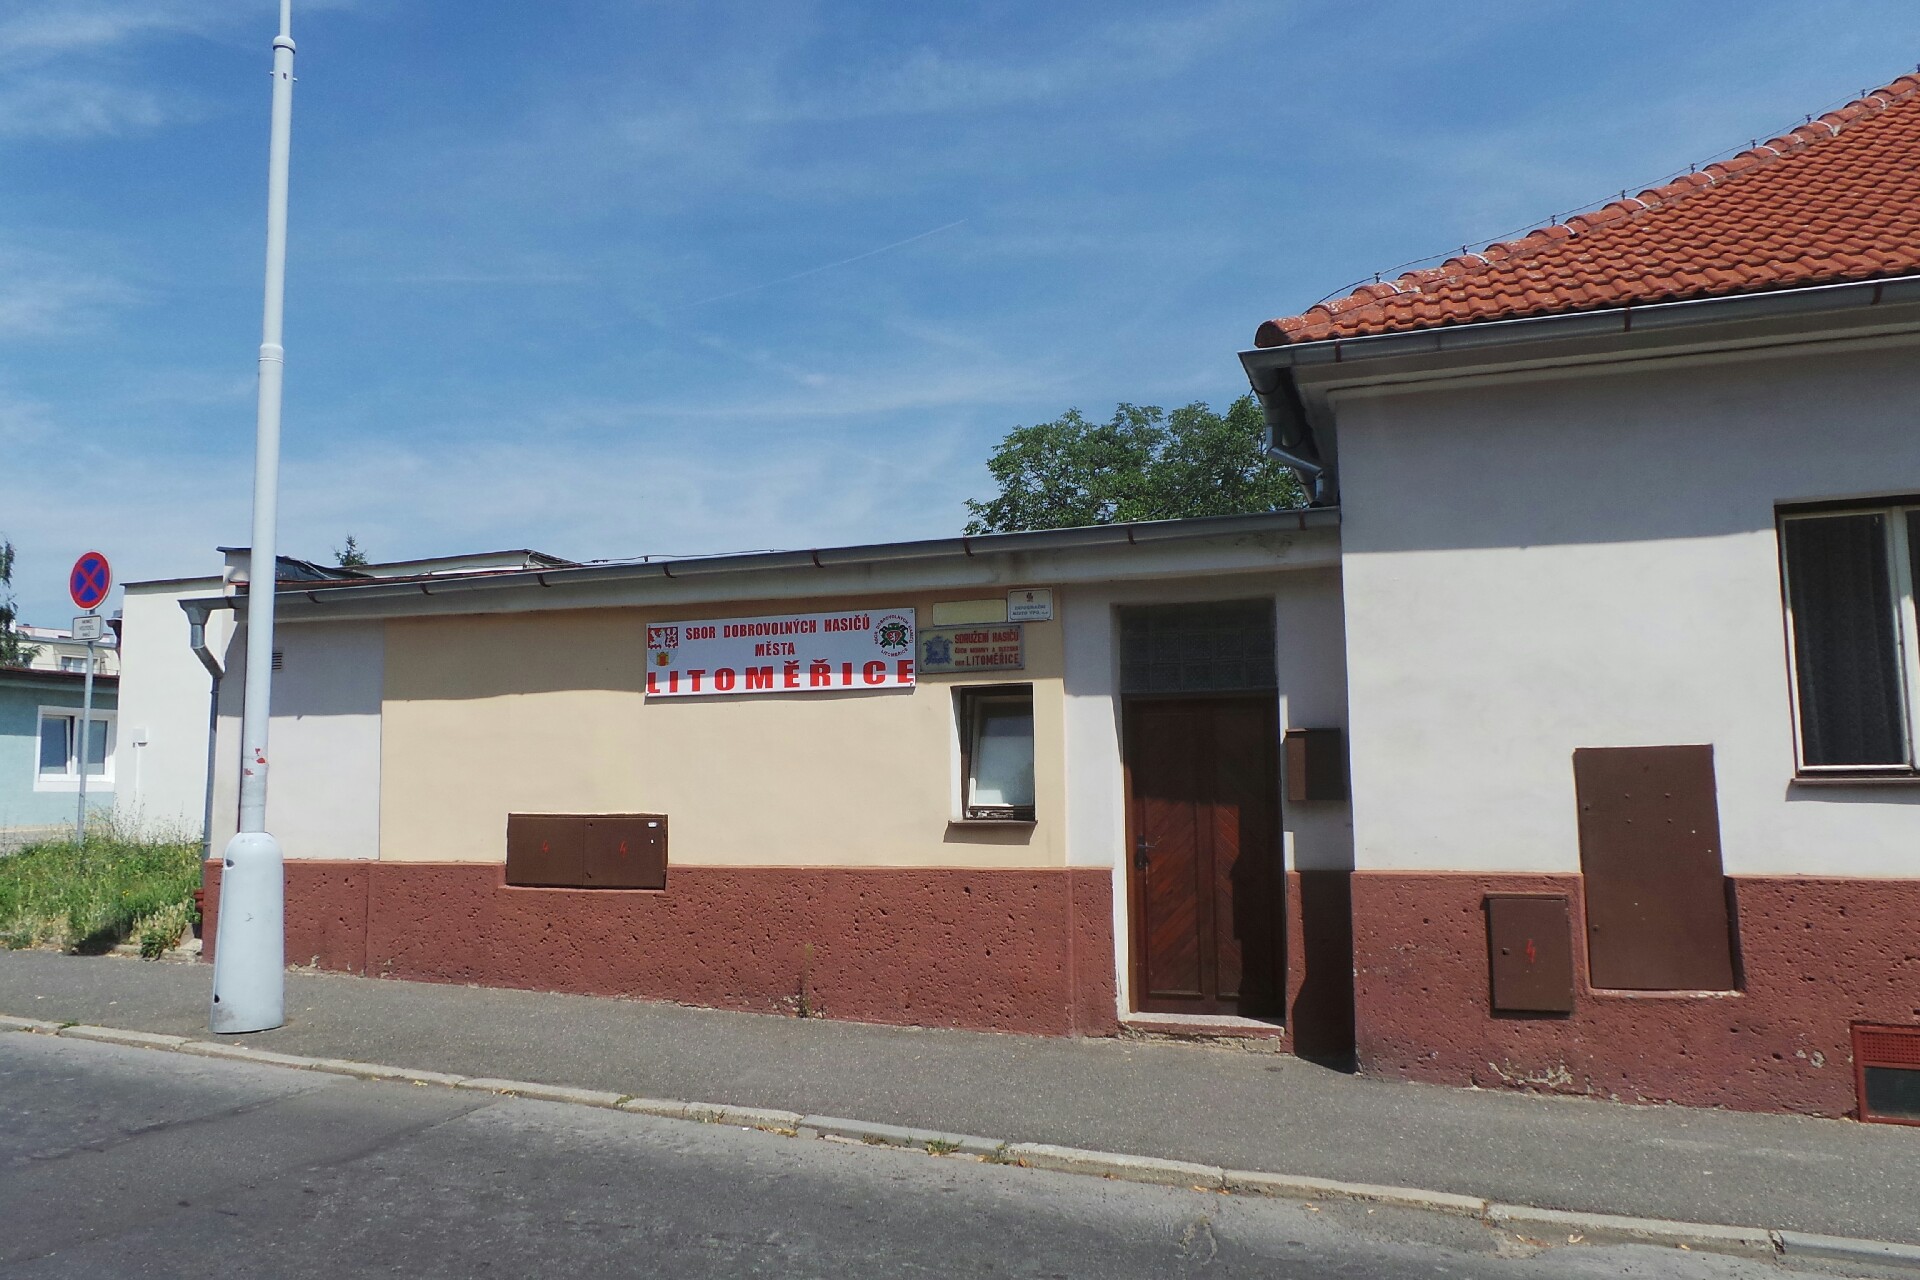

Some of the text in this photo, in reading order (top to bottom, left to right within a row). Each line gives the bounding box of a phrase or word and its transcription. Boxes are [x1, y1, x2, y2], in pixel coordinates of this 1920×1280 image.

[685, 613, 870, 640] SBOR DOBROVOLNÝCH HASIČŮ
[955, 629, 1019, 644] SDRUŽENÍ HASIČŮ
[755, 641, 795, 656] MĚSTA
[966, 652, 1019, 666] LITOMĚŘICE
[647, 659, 914, 693] LITOMĚŘICE
